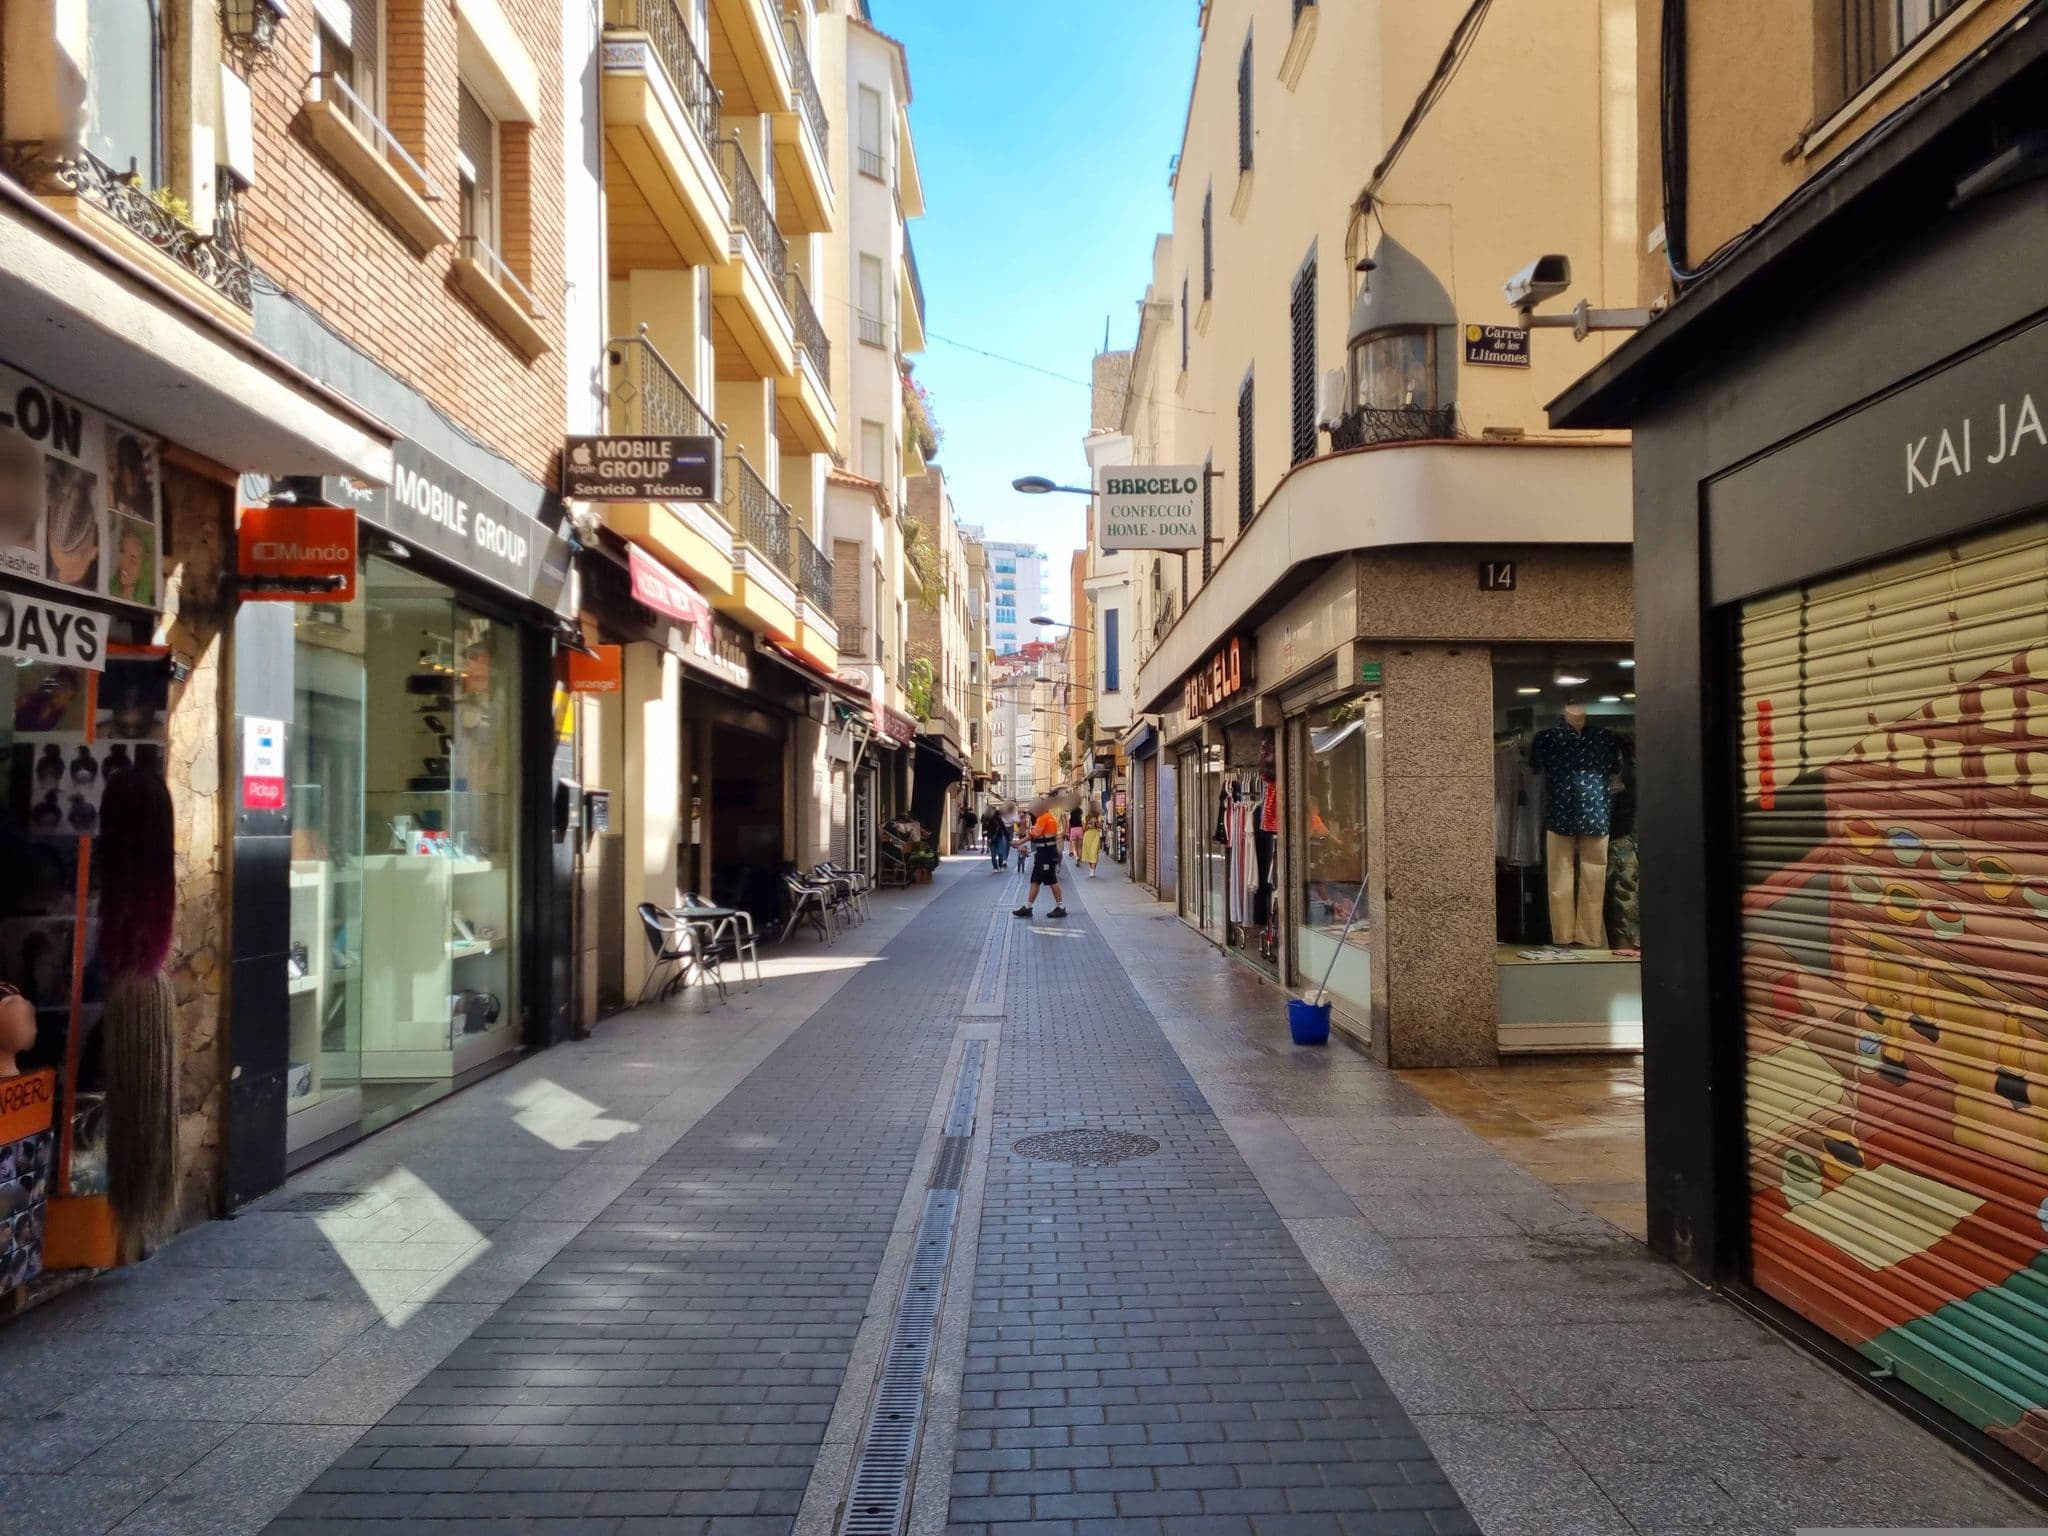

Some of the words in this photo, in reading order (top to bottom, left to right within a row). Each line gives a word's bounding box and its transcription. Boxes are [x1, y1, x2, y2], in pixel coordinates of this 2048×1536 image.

[1486, 327, 1526, 340] Carrer
[1495, 339, 1506, 350] de
[1471, 348, 1527, 363] Llimones
[597, 440, 673, 459] MOBILE
[1906, 418, 1971, 494] KAI
[1987, 394, 2048, 464] JA
[568, 464, 597, 475] Apple
[600, 461, 670, 479] GROUP
[575, 483, 637, 496] Servicio
[643, 482, 703, 496] Técnico
[1107, 477, 1198, 496] BARCELO
[396, 463, 469, 538] MOBILE
[475, 511, 528, 567] GROUP
[1107, 523, 1149, 537] HOME
[1159, 523, 1198, 537] DONA
[1488, 563, 1512, 588] 14
[575, 680, 616, 691] orange
